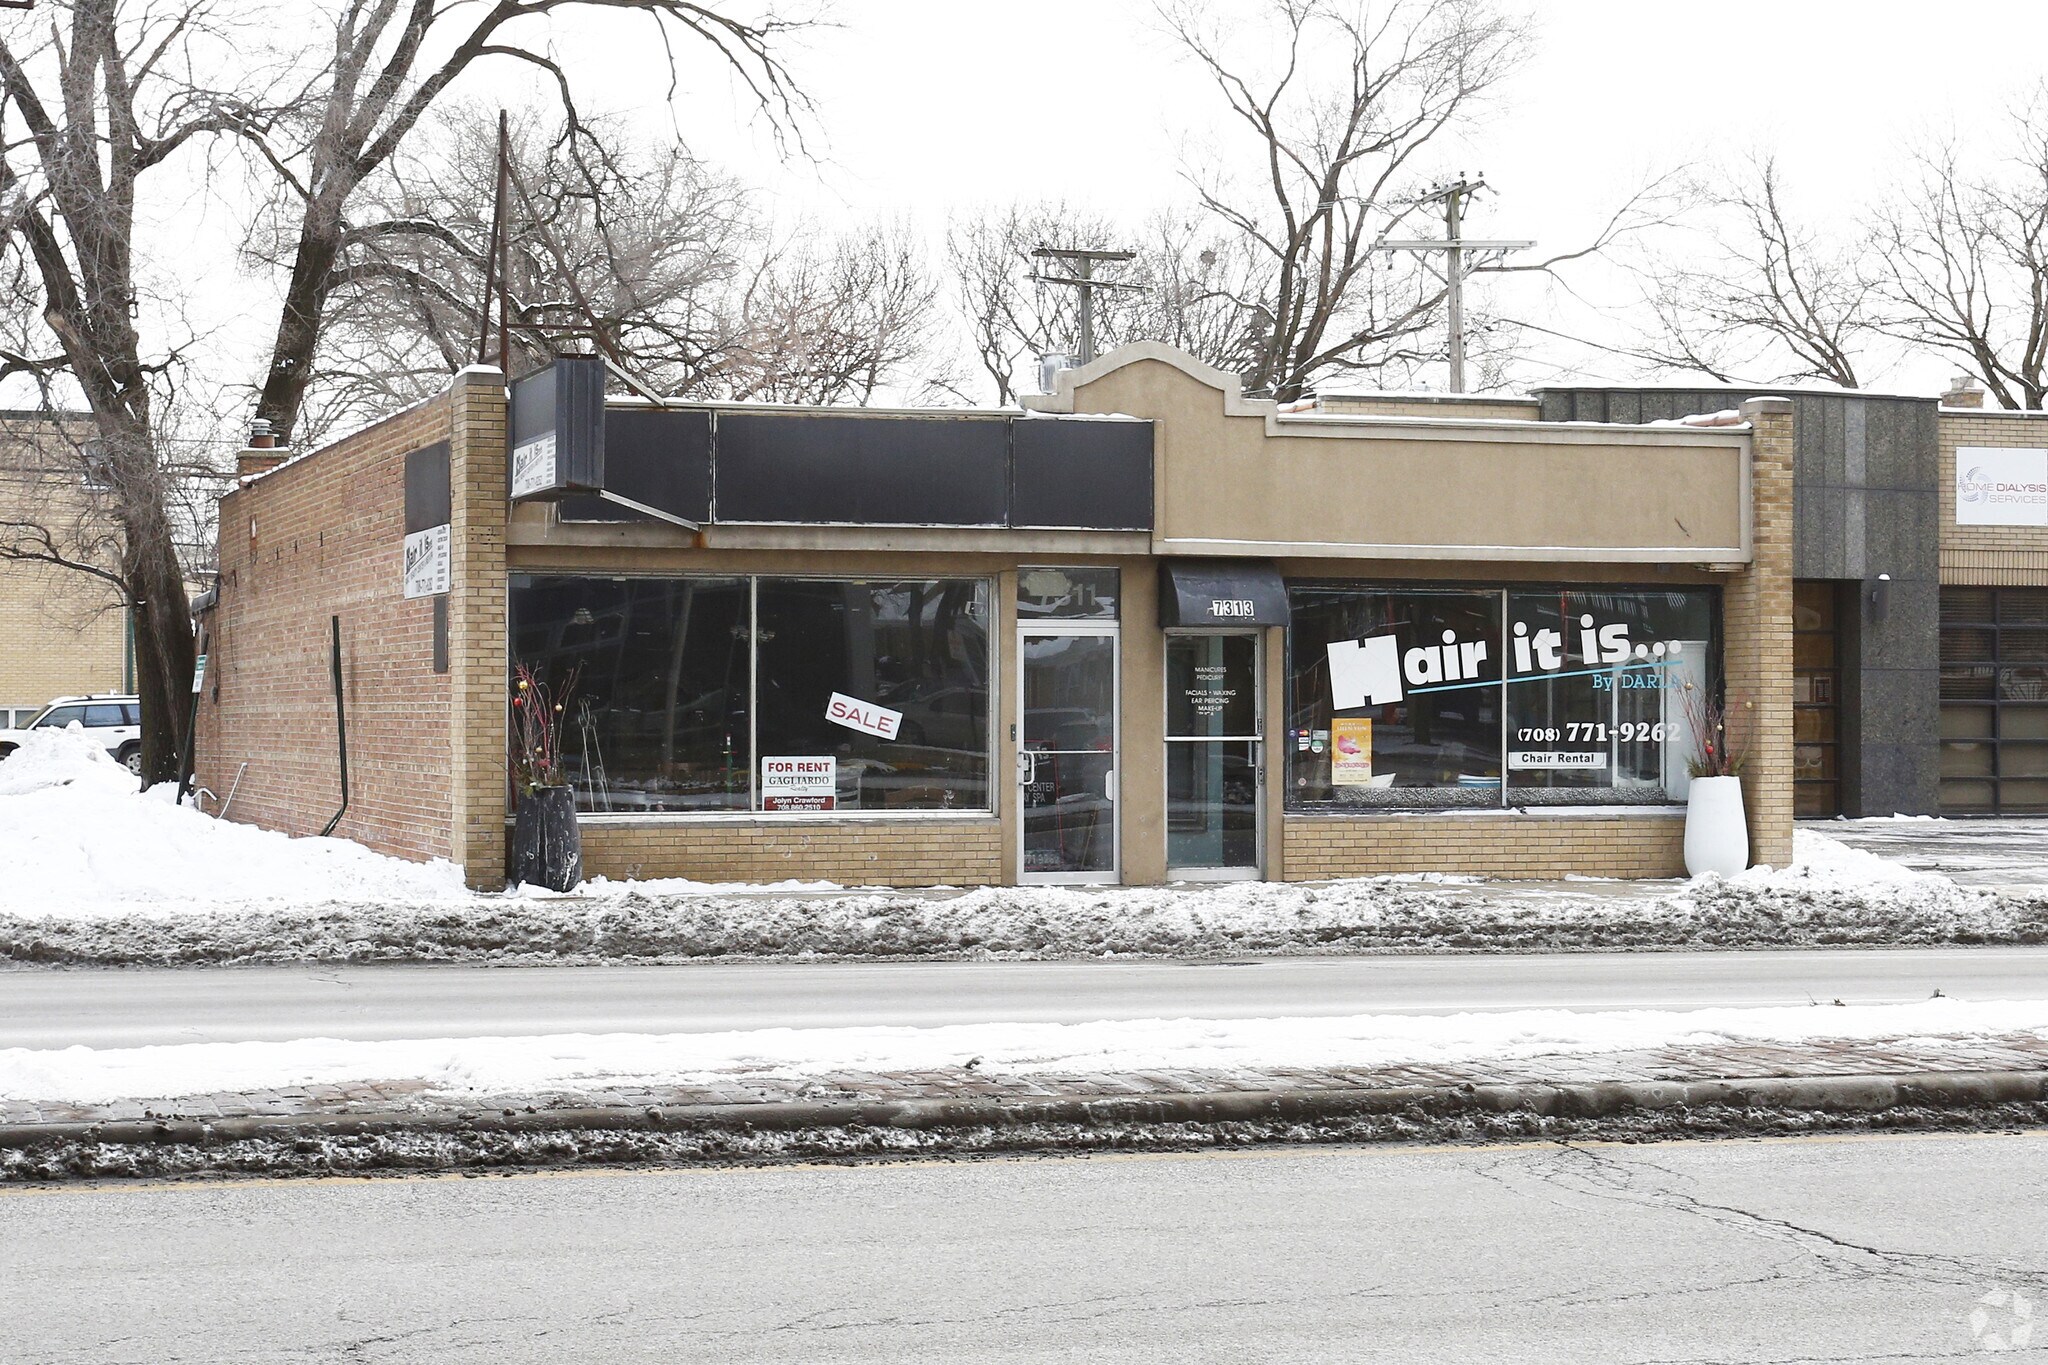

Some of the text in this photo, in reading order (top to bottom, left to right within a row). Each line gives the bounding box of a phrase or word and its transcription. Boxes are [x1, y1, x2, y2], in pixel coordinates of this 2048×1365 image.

[1996, 483, 2047, 493] DIALYSIS
[1989, 495, 2047, 504] SERVICES
[1214, 601, 1253, 616] 7313
[1326, 613, 1682, 711] Hair it is...
[1592, 674, 1613, 692] By
[830, 702, 894, 733] SALE
[1517, 722, 1681, 742] (708) 771-9262
[1521, 753, 1595, 763] Chair Rental
[768, 763, 830, 772] FOR RENT
[769, 776, 829, 785] GAGLIARDO
[1028, 782, 1055, 792] CENTER
[773, 797, 792, 805] Jolyn
